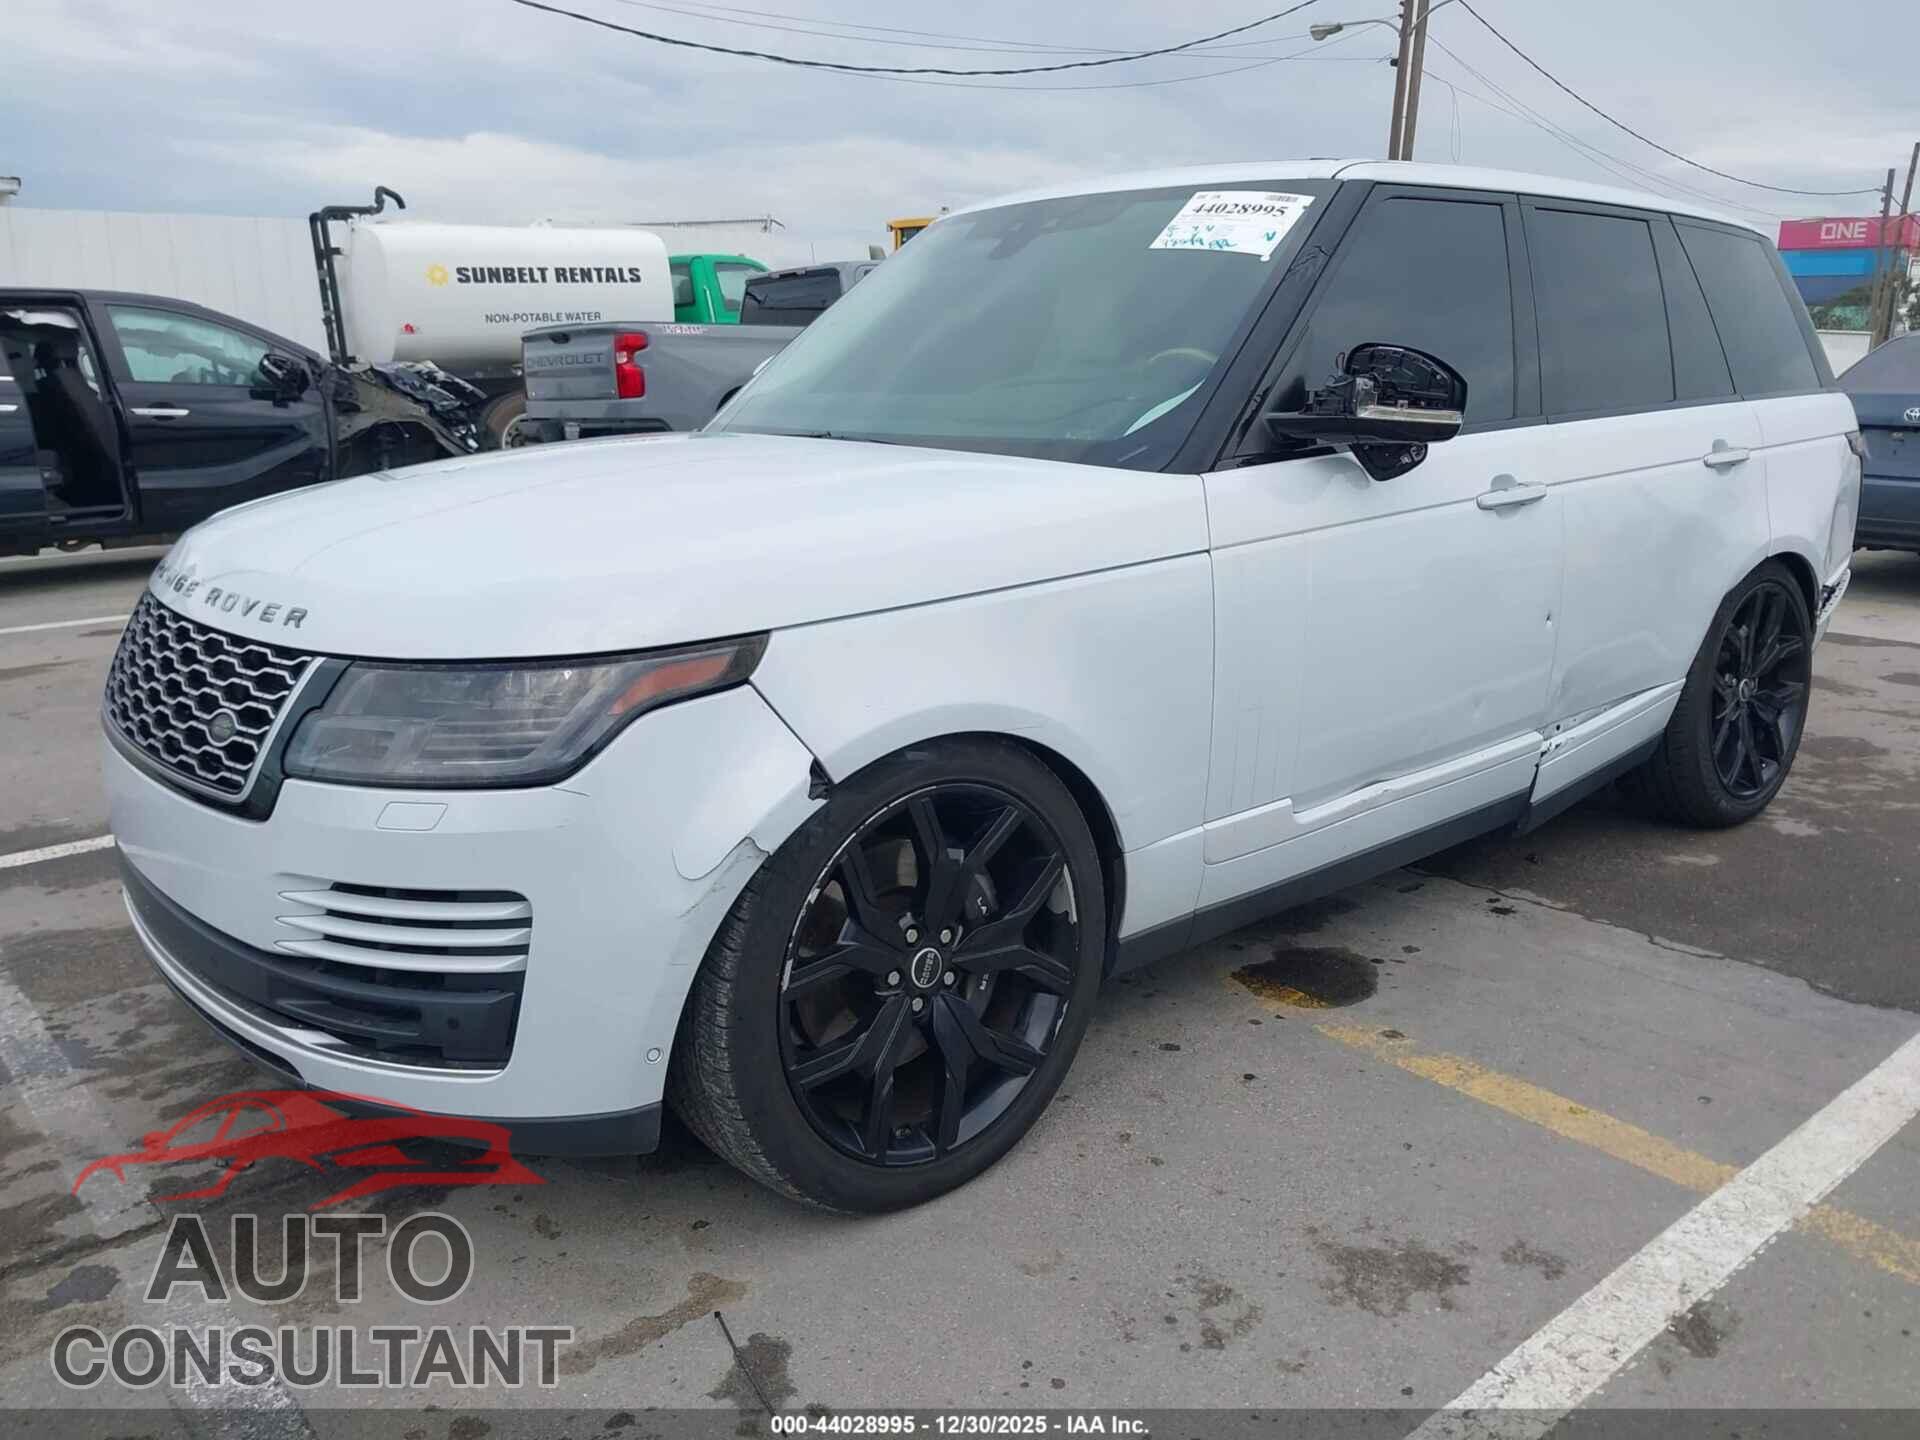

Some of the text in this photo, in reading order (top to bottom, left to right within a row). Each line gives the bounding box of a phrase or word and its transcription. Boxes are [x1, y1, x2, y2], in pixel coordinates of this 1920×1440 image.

[1192, 203, 1288, 217] 44028995
[1820, 221, 1868, 241] ONE
[456, 266, 642, 284] SUNBELT RENTALS
[485, 311, 601, 324] NON-POTABLE WATER
[526, 352, 604, 369] CHEVROLET
[204, 587, 308, 629] ROVER
